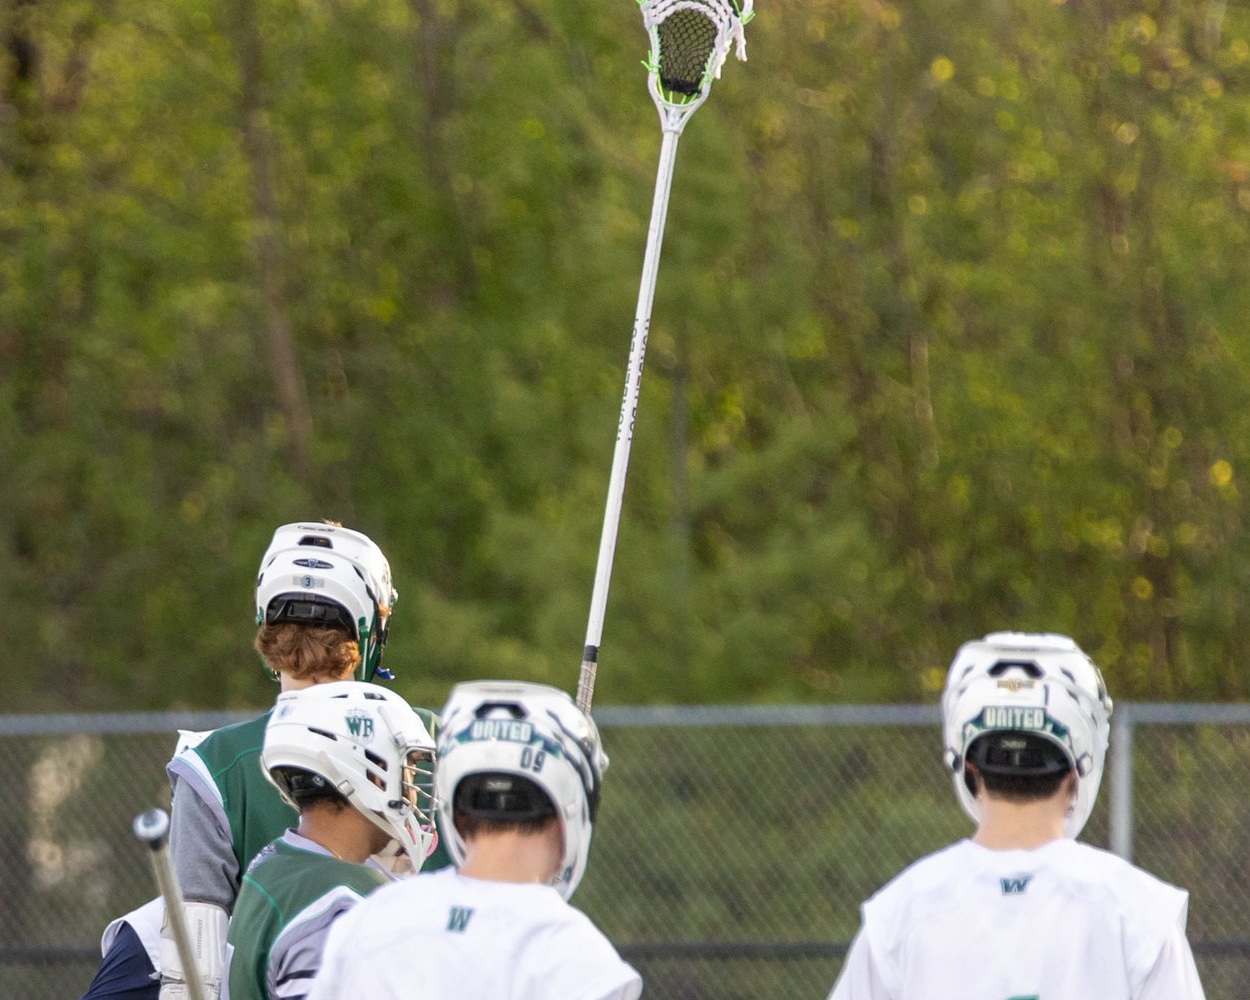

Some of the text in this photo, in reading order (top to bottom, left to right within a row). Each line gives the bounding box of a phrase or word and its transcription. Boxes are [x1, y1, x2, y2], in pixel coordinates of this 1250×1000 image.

[985, 706, 1046, 729] UNITED
[471, 719, 532, 743] UNITED
[519, 748, 546, 773] 09
[1000, 876, 1033, 895] W
[446, 905, 474, 932] W
